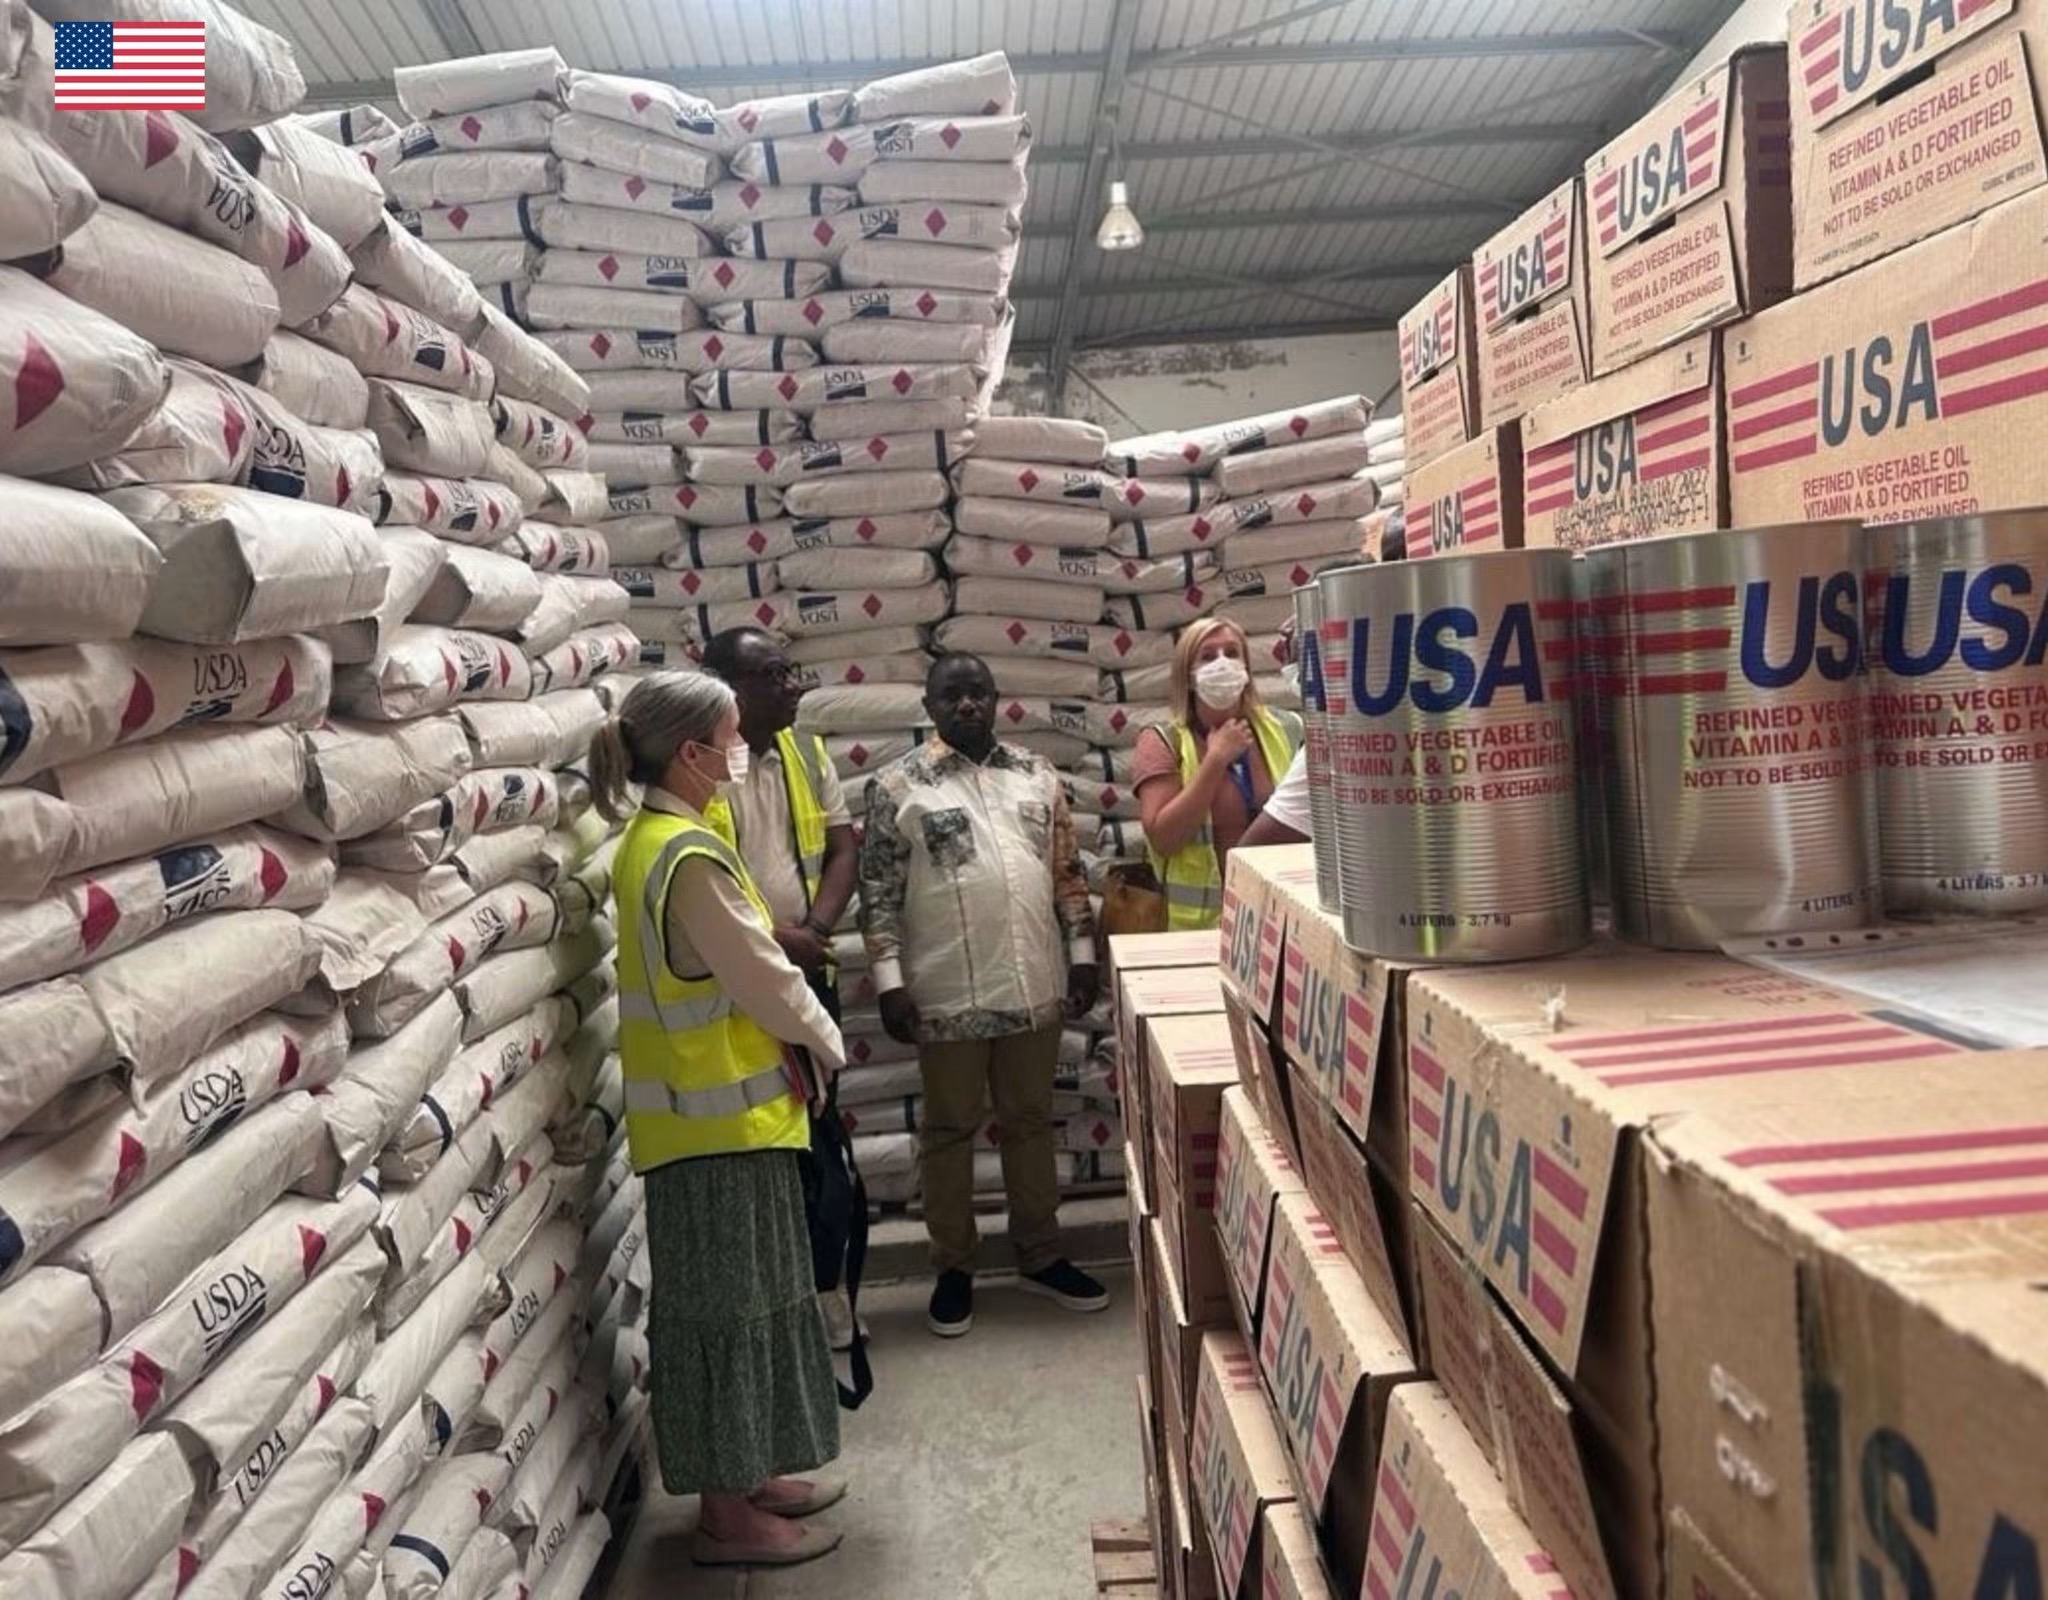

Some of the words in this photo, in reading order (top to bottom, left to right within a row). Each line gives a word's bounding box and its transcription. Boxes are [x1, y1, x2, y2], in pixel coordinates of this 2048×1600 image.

[1842, 0, 1956, 93] USA
[1828, 126, 1885, 173] REFINED
[1888, 74, 1981, 141] VEGETABLE
[1985, 58, 2015, 90] OIL
[1617, 125, 1688, 233] USA
[1829, 161, 1882, 204] VITAMIN
[1885, 155, 1896, 178] A
[1898, 151, 1909, 172] &
[1912, 144, 1923, 165] D
[1926, 97, 2013, 158] FORTIFIED
[1823, 215, 1844, 237] NOT
[1846, 206, 1862, 225] TO
[1864, 197, 1880, 217] BE
[1881, 179, 1914, 208] SOLD
[1915, 170, 1934, 192] OR
[1937, 129, 2022, 183] EXCHANGED
[1498, 234, 1547, 313] USA
[1610, 261, 1645, 289] REFINED
[1646, 232, 1702, 275] VEGETABLE
[1703, 222, 1721, 244] OIL
[1669, 251, 1721, 291] FORTIFIED
[1413, 311, 1442, 375] USA
[1822, 320, 1939, 447] USA
[1574, 413, 1638, 500] USA
[1803, 471, 1854, 499] REFINED
[1856, 450, 1939, 488] VEGETABLE
[1943, 445, 1970, 469] OIL
[1432, 491, 1465, 551] USA
[1804, 496, 1852, 521] VITAMIN
[1854, 493, 1864, 511] A
[1866, 490, 1876, 509] &
[1879, 488, 1888, 507] D
[1892, 472, 1969, 503] FORTIFIED
[193, 653, 247, 695] USDA
[1351, 602, 1544, 717] USA
[1404, 724, 1536, 753] VEGETABLE
[1541, 719, 1564, 741] OIL
[1689, 731, 1800, 759] VITAMIN
[1806, 731, 1823, 751] A
[1828, 727, 1841, 749] &
[1695, 704, 1803, 736] REFINED
[1947, 717, 1965, 736] A
[1975, 714, 1995, 736] &
[2003, 712, 2021, 733] D
[1402, 758, 1417, 776] A
[1424, 757, 1442, 775] &
[1451, 754, 1468, 774] D
[1684, 767, 1729, 789] NOT
[1732, 764, 1762, 787] TO
[1768, 762, 1793, 785] BE
[1799, 758, 1844, 782] SOLD
[1906, 749, 1932, 767] BE
[1938, 747, 1995, 767] SOLD
[2001, 744, 2028, 763] OR
[1394, 787, 1443, 805] SOLD
[1451, 784, 1475, 802] OR
[1937, 878, 1947, 890] 4
[1952, 874, 2005, 891] LITERS
[1399, 915, 1407, 926] 4
[1299, 969, 1347, 1098] USA
[180, 1065, 246, 1125] USDA
[1440, 1077, 1532, 1297] USA
[192, 1264, 266, 1334] USDA
[1277, 1290, 1324, 1466] USA
